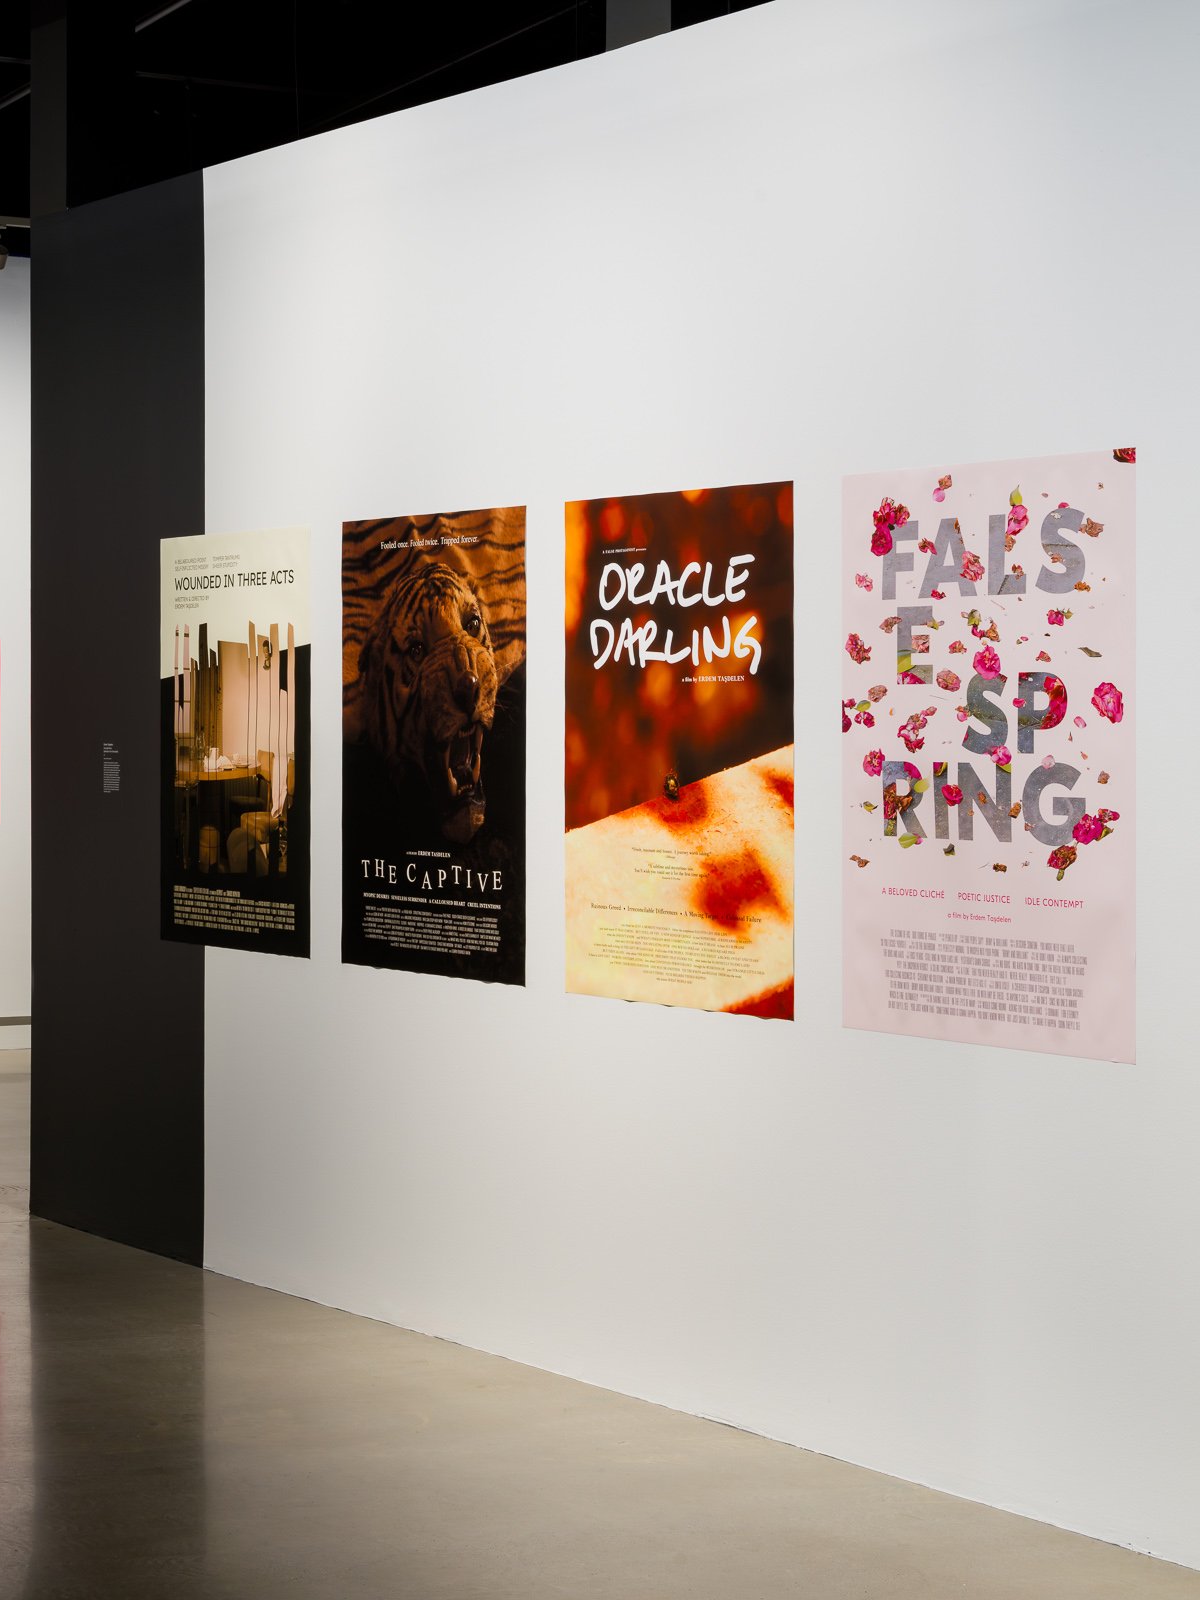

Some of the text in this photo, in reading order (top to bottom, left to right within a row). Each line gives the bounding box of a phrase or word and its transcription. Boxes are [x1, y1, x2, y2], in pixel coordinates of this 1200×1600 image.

[380, 541, 397, 550] Fooled
[410, 539, 425, 548] Fooled
[425, 538, 440, 546] twice.
[440, 536, 460, 546] Trapped
[460, 535, 480, 544] forever.
[881, 507, 1086, 600] FALS
[174, 569, 295, 591] WOUNDED IN THREE ACTS
[599, 554, 756, 611] ORACLE
[590, 615, 762, 675] DARLING
[896, 605, 934, 685] E
[962, 671, 1068, 755] SP
[882, 761, 1086, 847] RING
[361, 859, 503, 893] THE CAPTIVE
[881, 887, 945, 899] A BELOVED CLICHÉ
[957, 892, 981, 902] POETIC
[1025, 897, 1084, 909] IDLE CONTEMPT
[962, 913, 969, 921] by
[970, 913, 986, 921] Erdem
